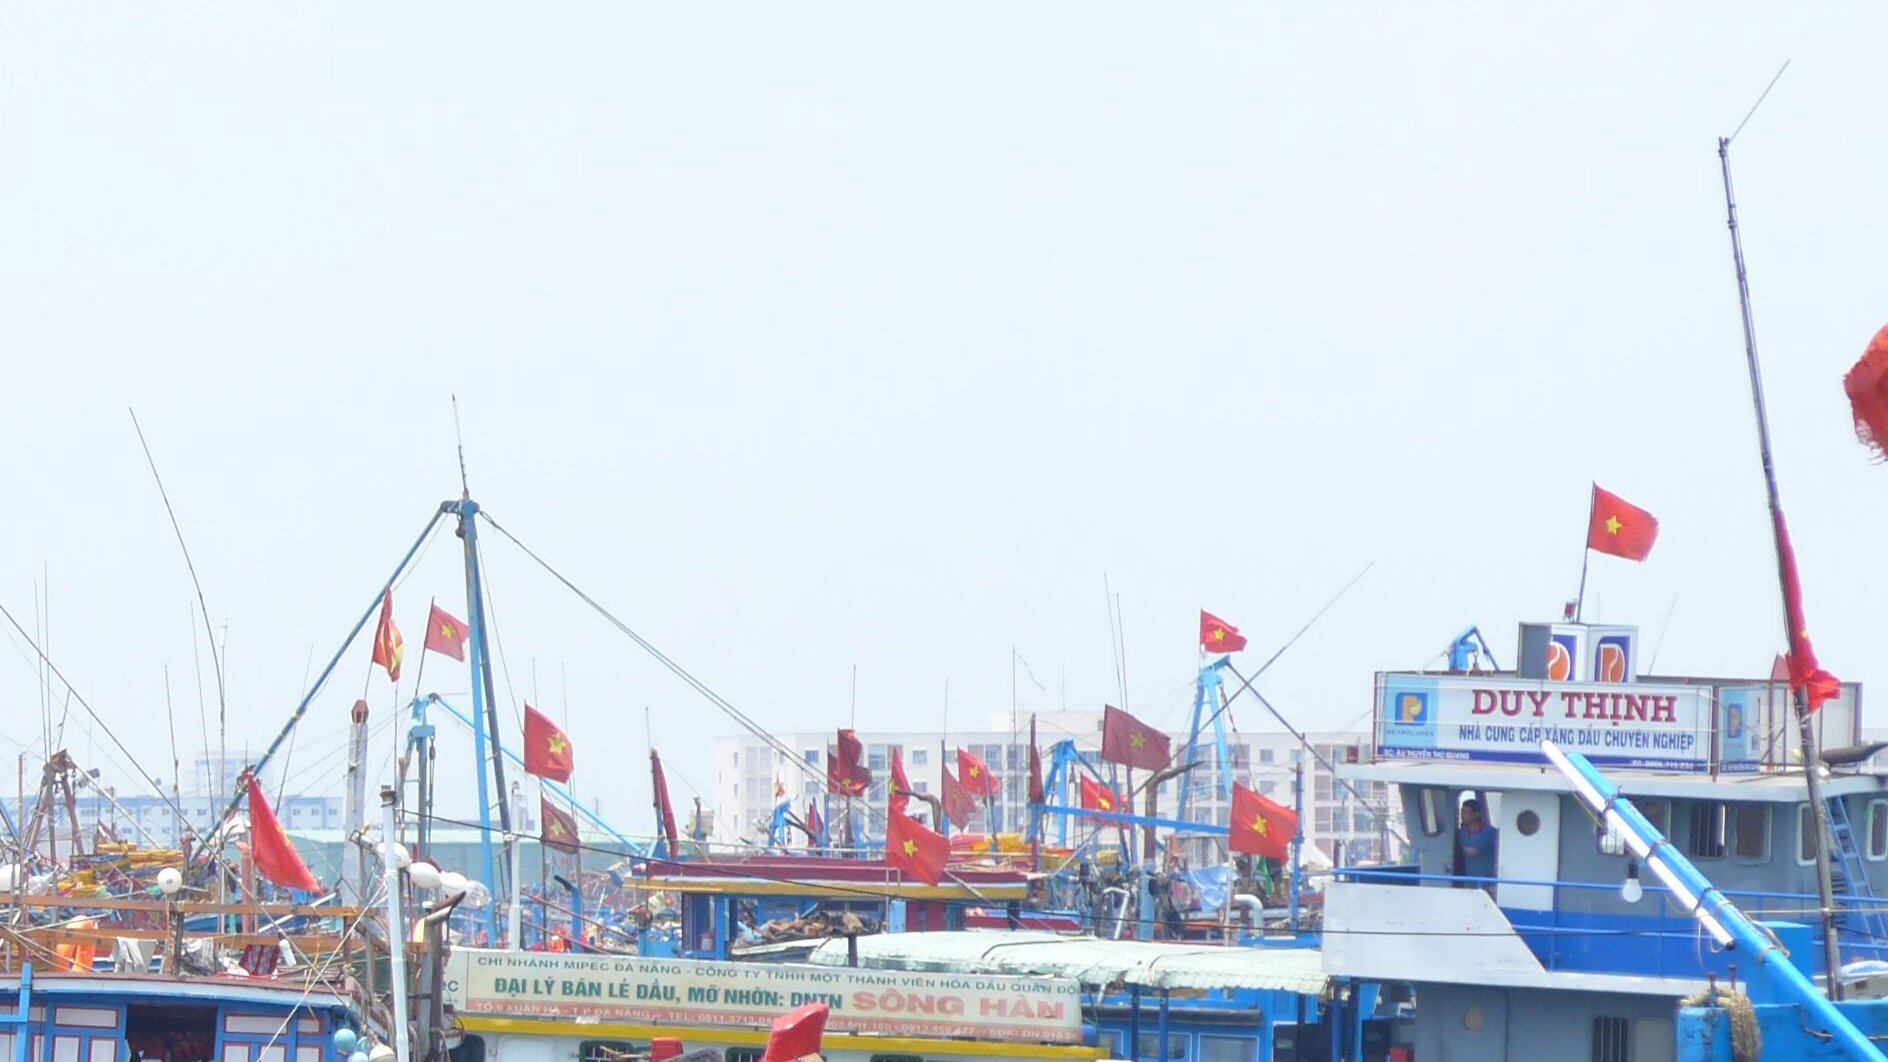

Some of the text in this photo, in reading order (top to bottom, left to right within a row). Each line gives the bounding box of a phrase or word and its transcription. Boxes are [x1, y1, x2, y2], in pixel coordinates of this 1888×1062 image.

[1471, 688, 1678, 727] DUY THỊNH
[1459, 721, 1481, 741] NHÀ
[1485, 725, 1515, 743] CUNG
[1519, 721, 1541, 744] CẤP
[1604, 728, 1649, 750] CHUYÊN
[1653, 730, 1694, 754] NGHIỆP
[477, 957, 503, 967] CHI
[564, 960, 609, 972] MIPEC
[695, 963, 738, 978] CÔNG
[744, 969, 761, 979] TY
[767, 970, 805, 981] TNHH
[810, 972, 842, 985] MỘT
[847, 973, 897, 987] THÀNH
[901, 976, 935, 988] VIÊN
[494, 977, 527, 998] ĐẠI
[533, 976, 556, 996] LÝ
[561, 978, 602, 998] BÁN
[790, 990, 843, 1010] DNTN
[852, 988, 965, 1016] SÔNG
[979, 993, 1065, 1021] HÀN
